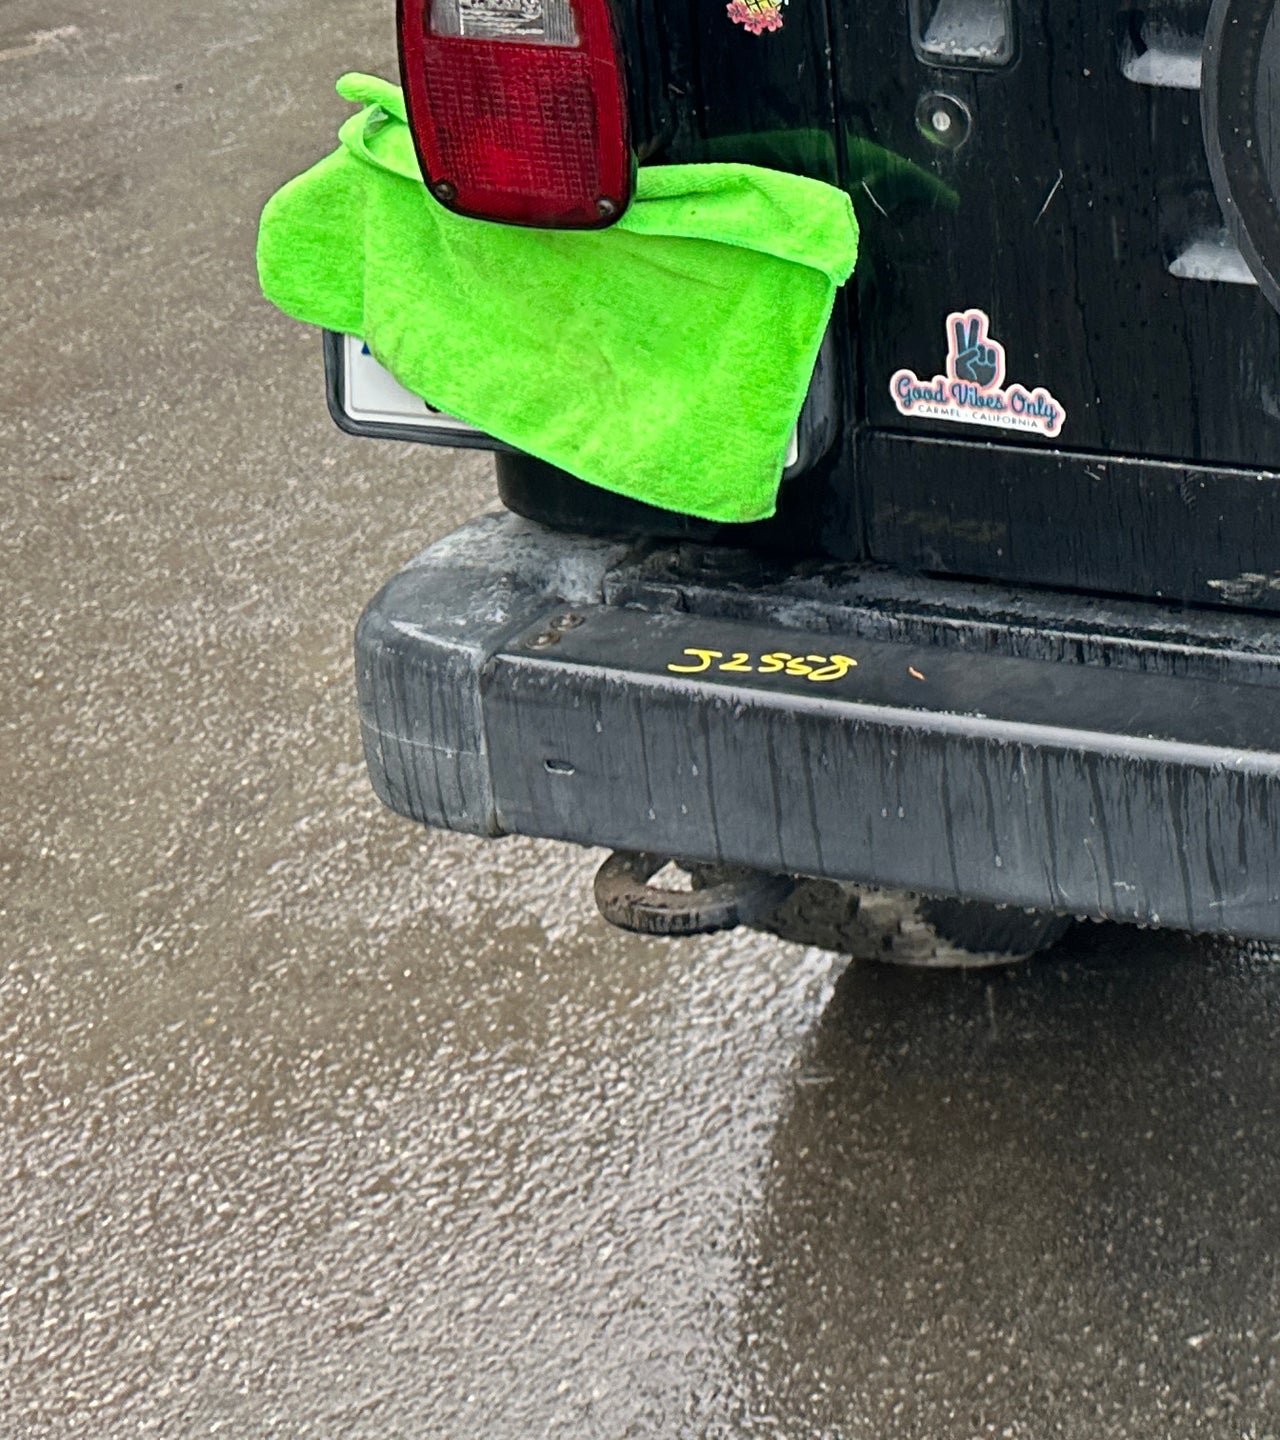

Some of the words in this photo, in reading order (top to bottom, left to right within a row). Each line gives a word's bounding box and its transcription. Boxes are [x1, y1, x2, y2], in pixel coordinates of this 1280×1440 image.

[898, 378, 948, 408] Good
[952, 383, 1007, 410] Vibes
[1011, 392, 1058, 429] Only
[918, 404, 960, 418] CARMEL
[972, 412, 1038, 428] CALIFORNIA
[667, 648, 858, 682] J2558
